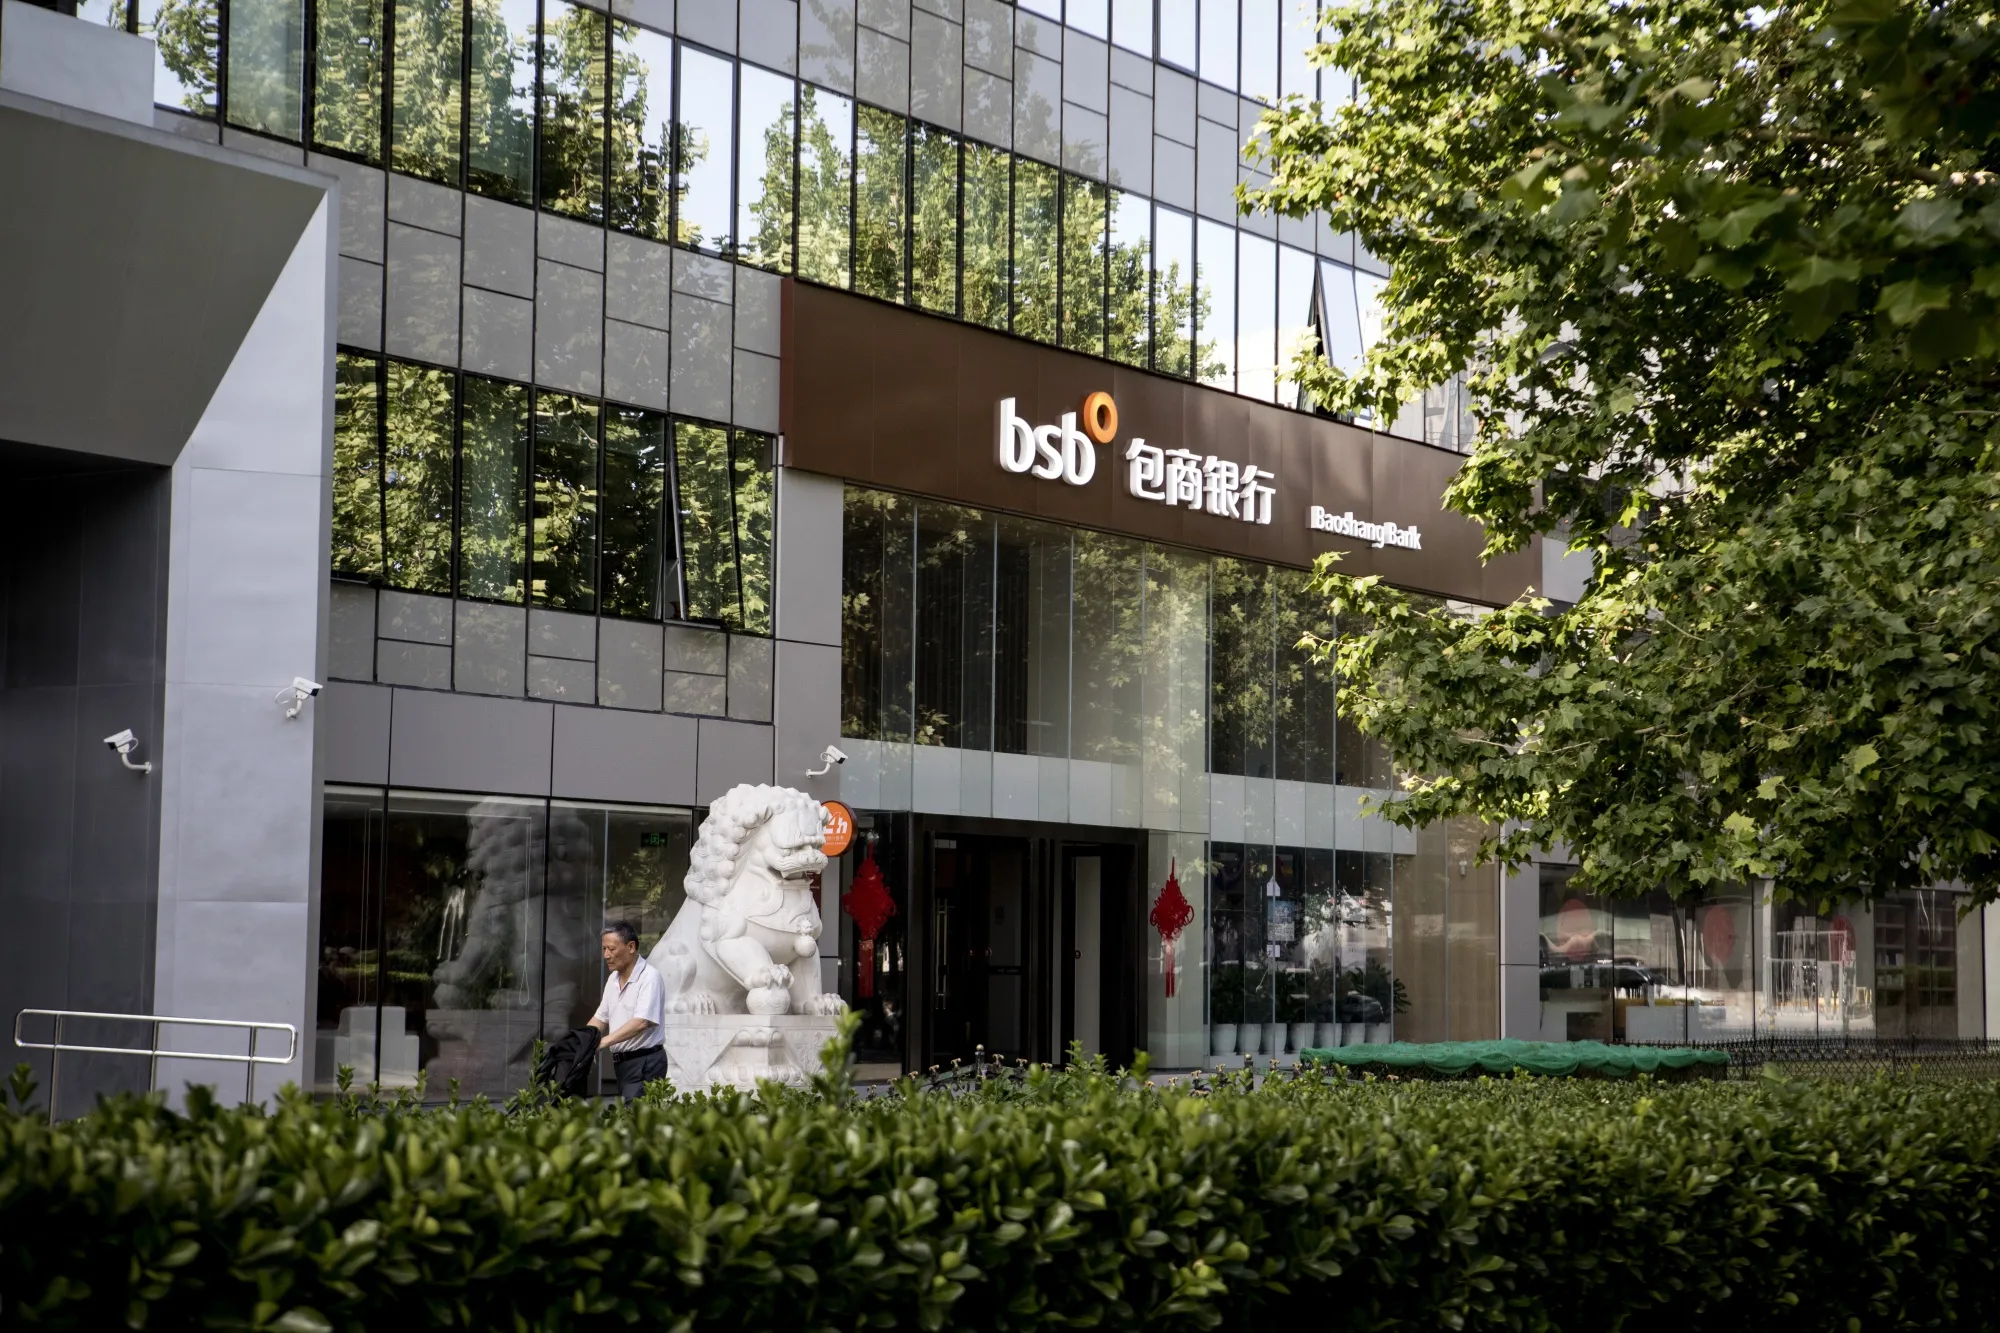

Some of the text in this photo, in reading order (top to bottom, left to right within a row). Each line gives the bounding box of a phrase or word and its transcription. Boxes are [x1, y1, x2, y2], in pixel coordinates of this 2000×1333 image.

[1125, 437, 1277, 525] 包商银行
[1310, 505, 1422, 550] Baoshang Bank
